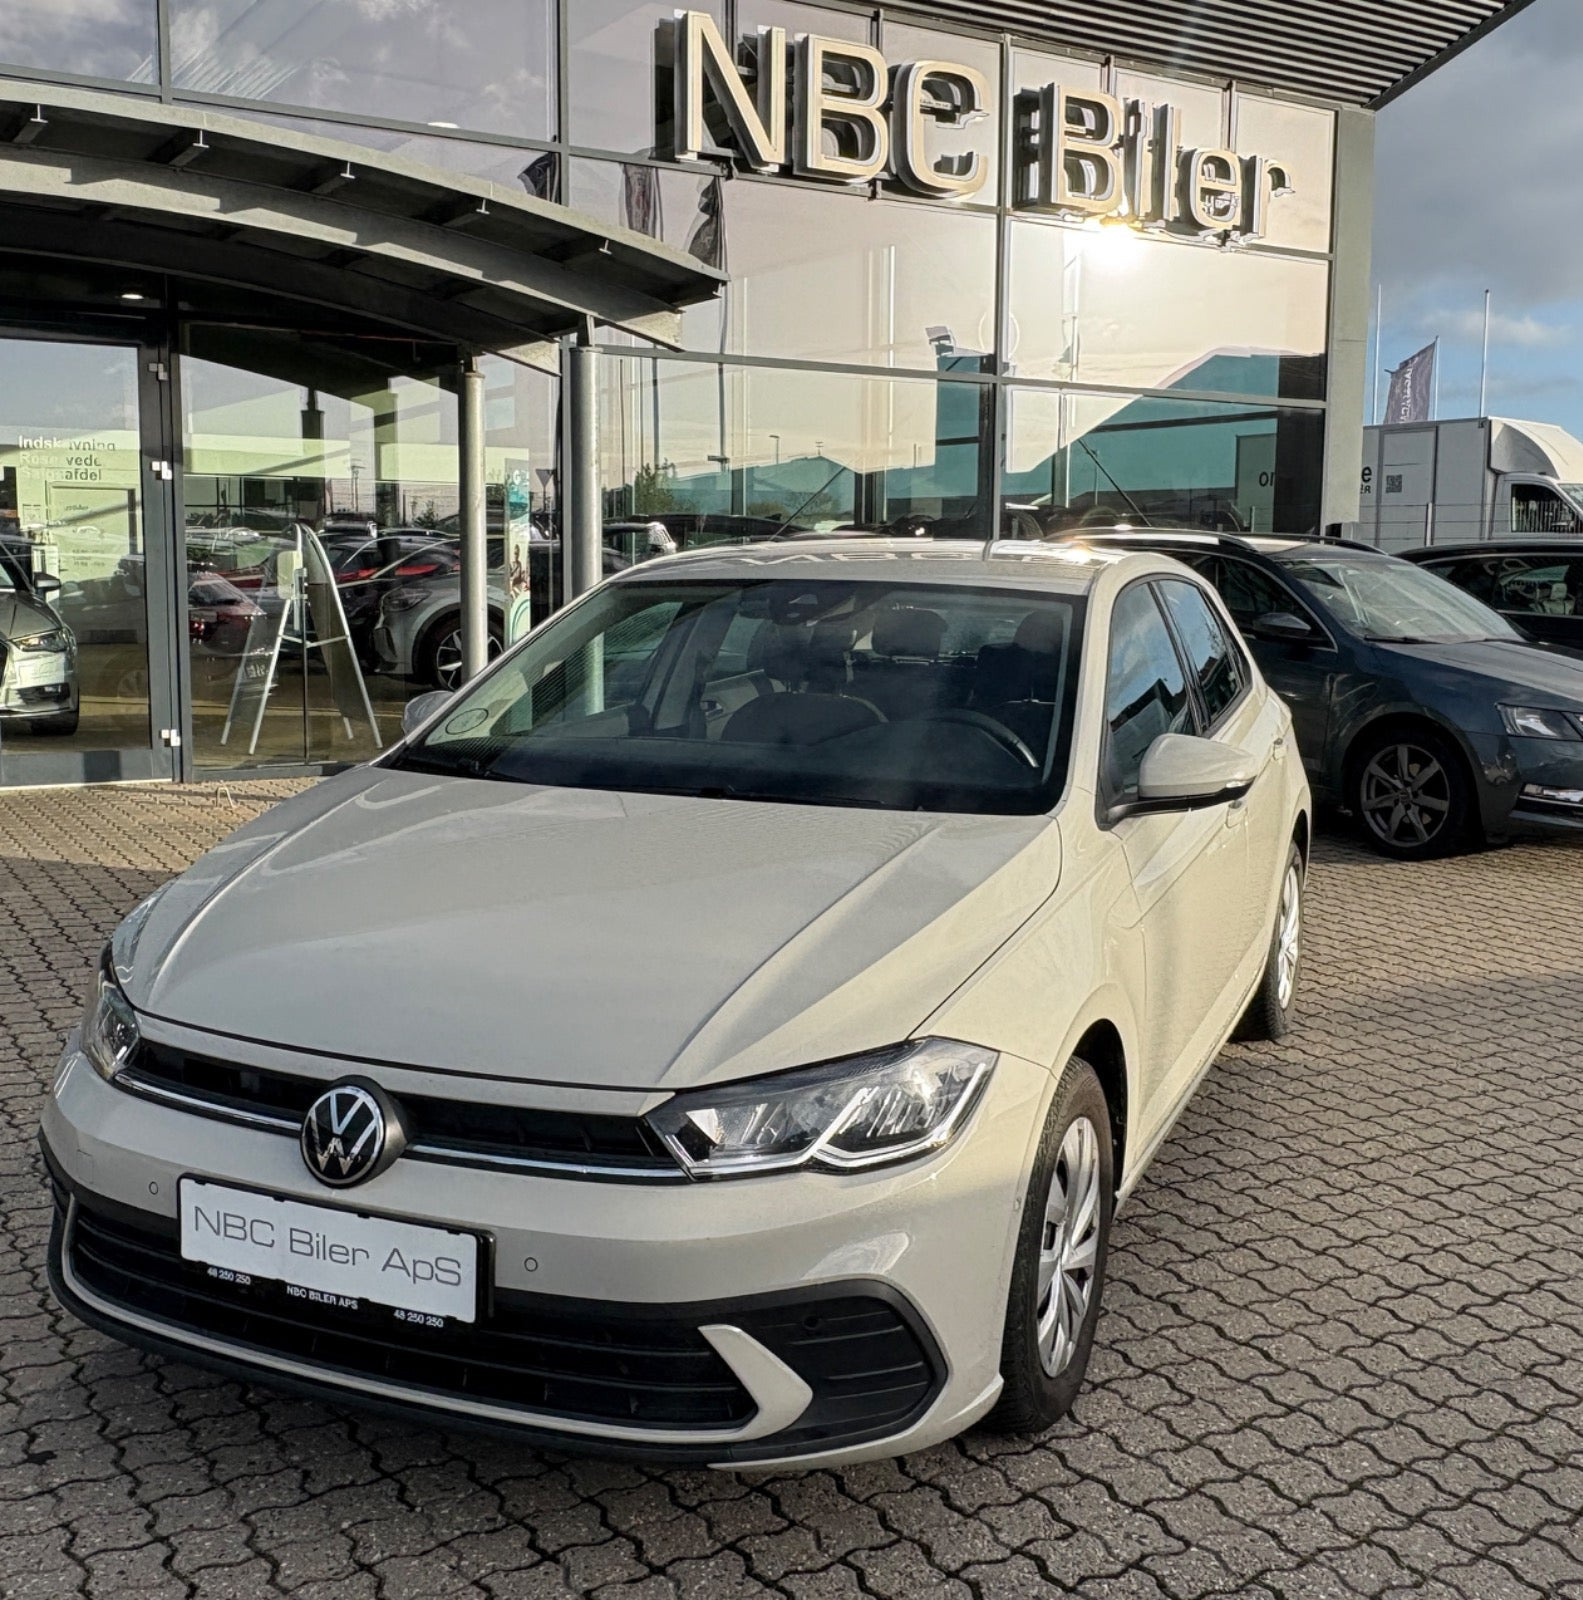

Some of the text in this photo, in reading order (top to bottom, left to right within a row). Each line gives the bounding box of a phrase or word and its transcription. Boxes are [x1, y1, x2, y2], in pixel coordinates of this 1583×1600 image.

[672, 9, 1295, 242] NBC Biler
[194, 1206, 462, 1286] NBC Biler ApS
[286, 1285, 359, 1310] NBC BILER APS
[407, 1311, 424, 1325] 250
[425, 1315, 444, 1328] 250
